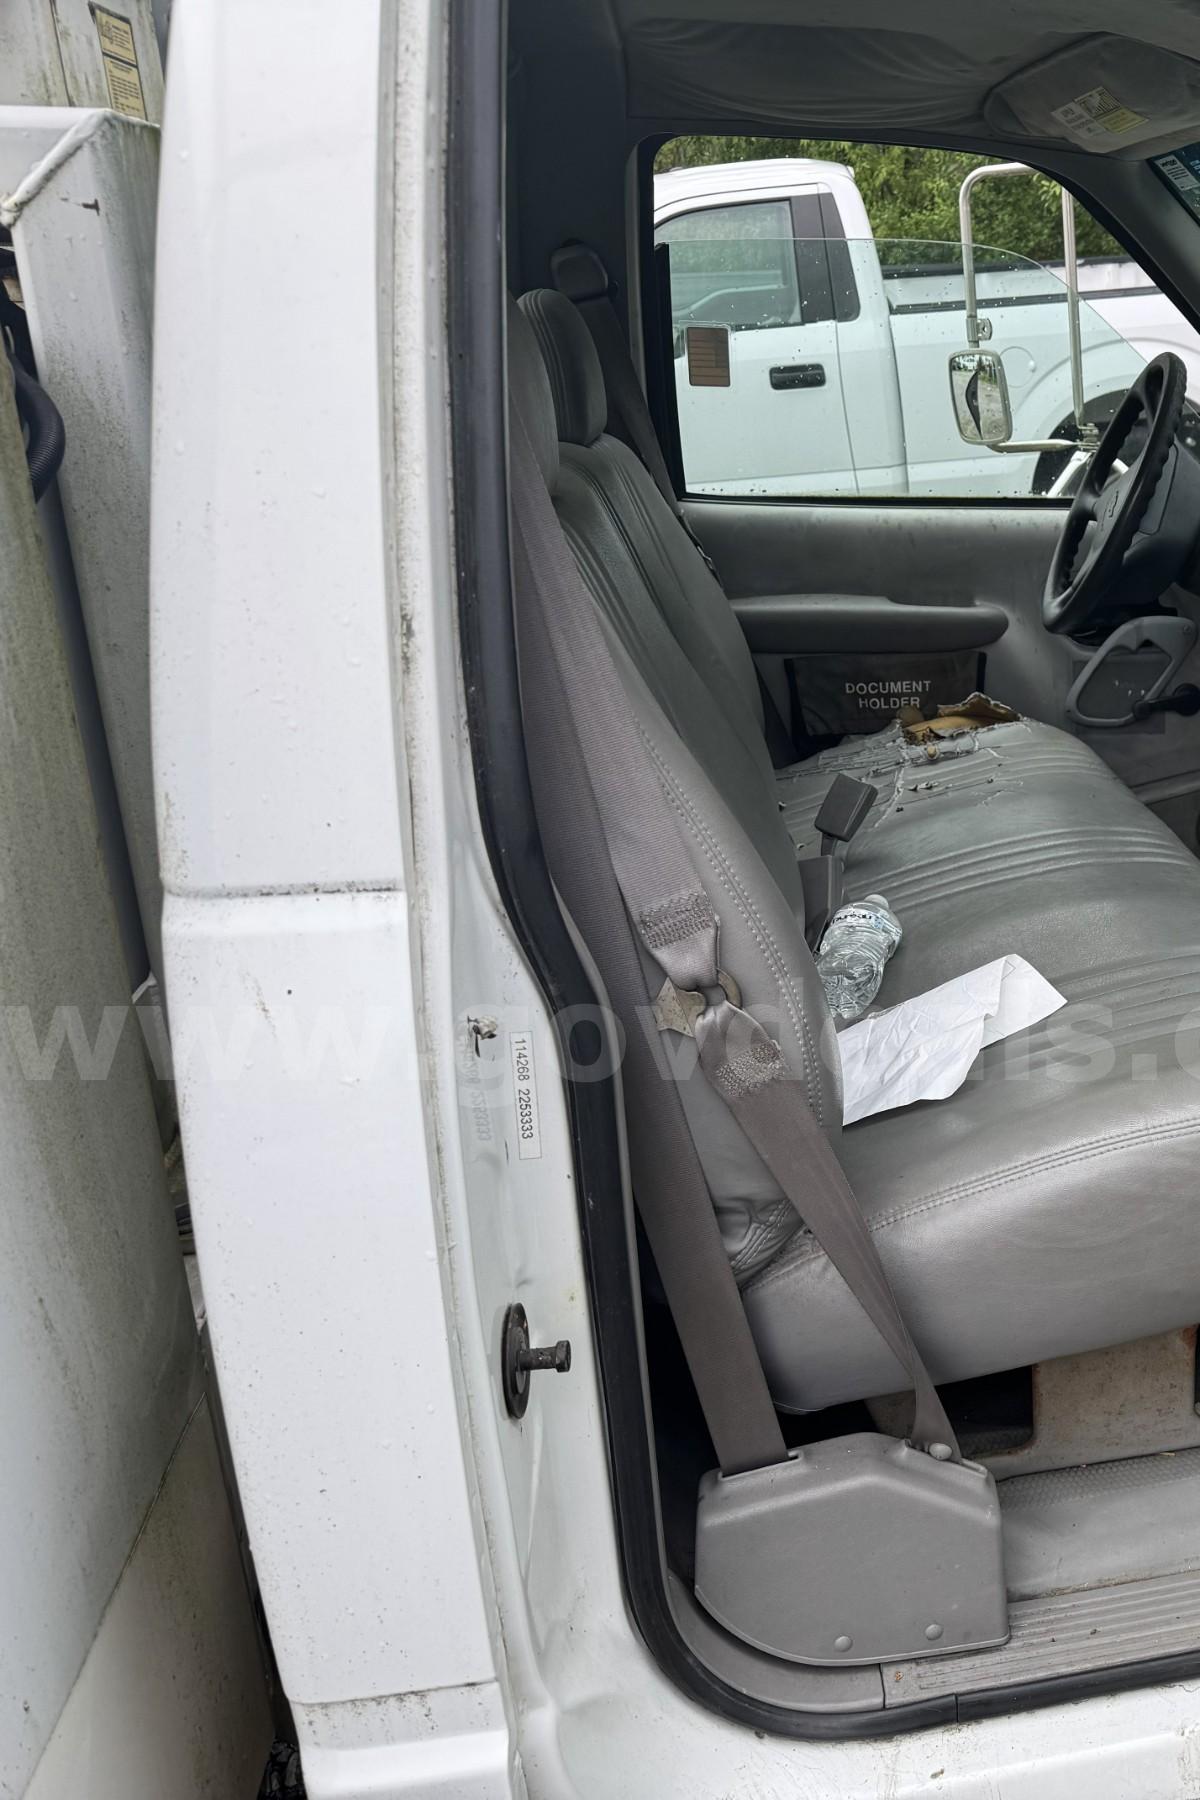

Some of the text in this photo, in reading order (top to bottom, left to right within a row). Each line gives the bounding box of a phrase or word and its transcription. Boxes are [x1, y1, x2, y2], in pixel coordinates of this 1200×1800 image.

[845, 680, 931, 695] DOCUMENT
[859, 696, 920, 709] HOLDER
[514, 1038, 534, 1140] 114268 2253333
